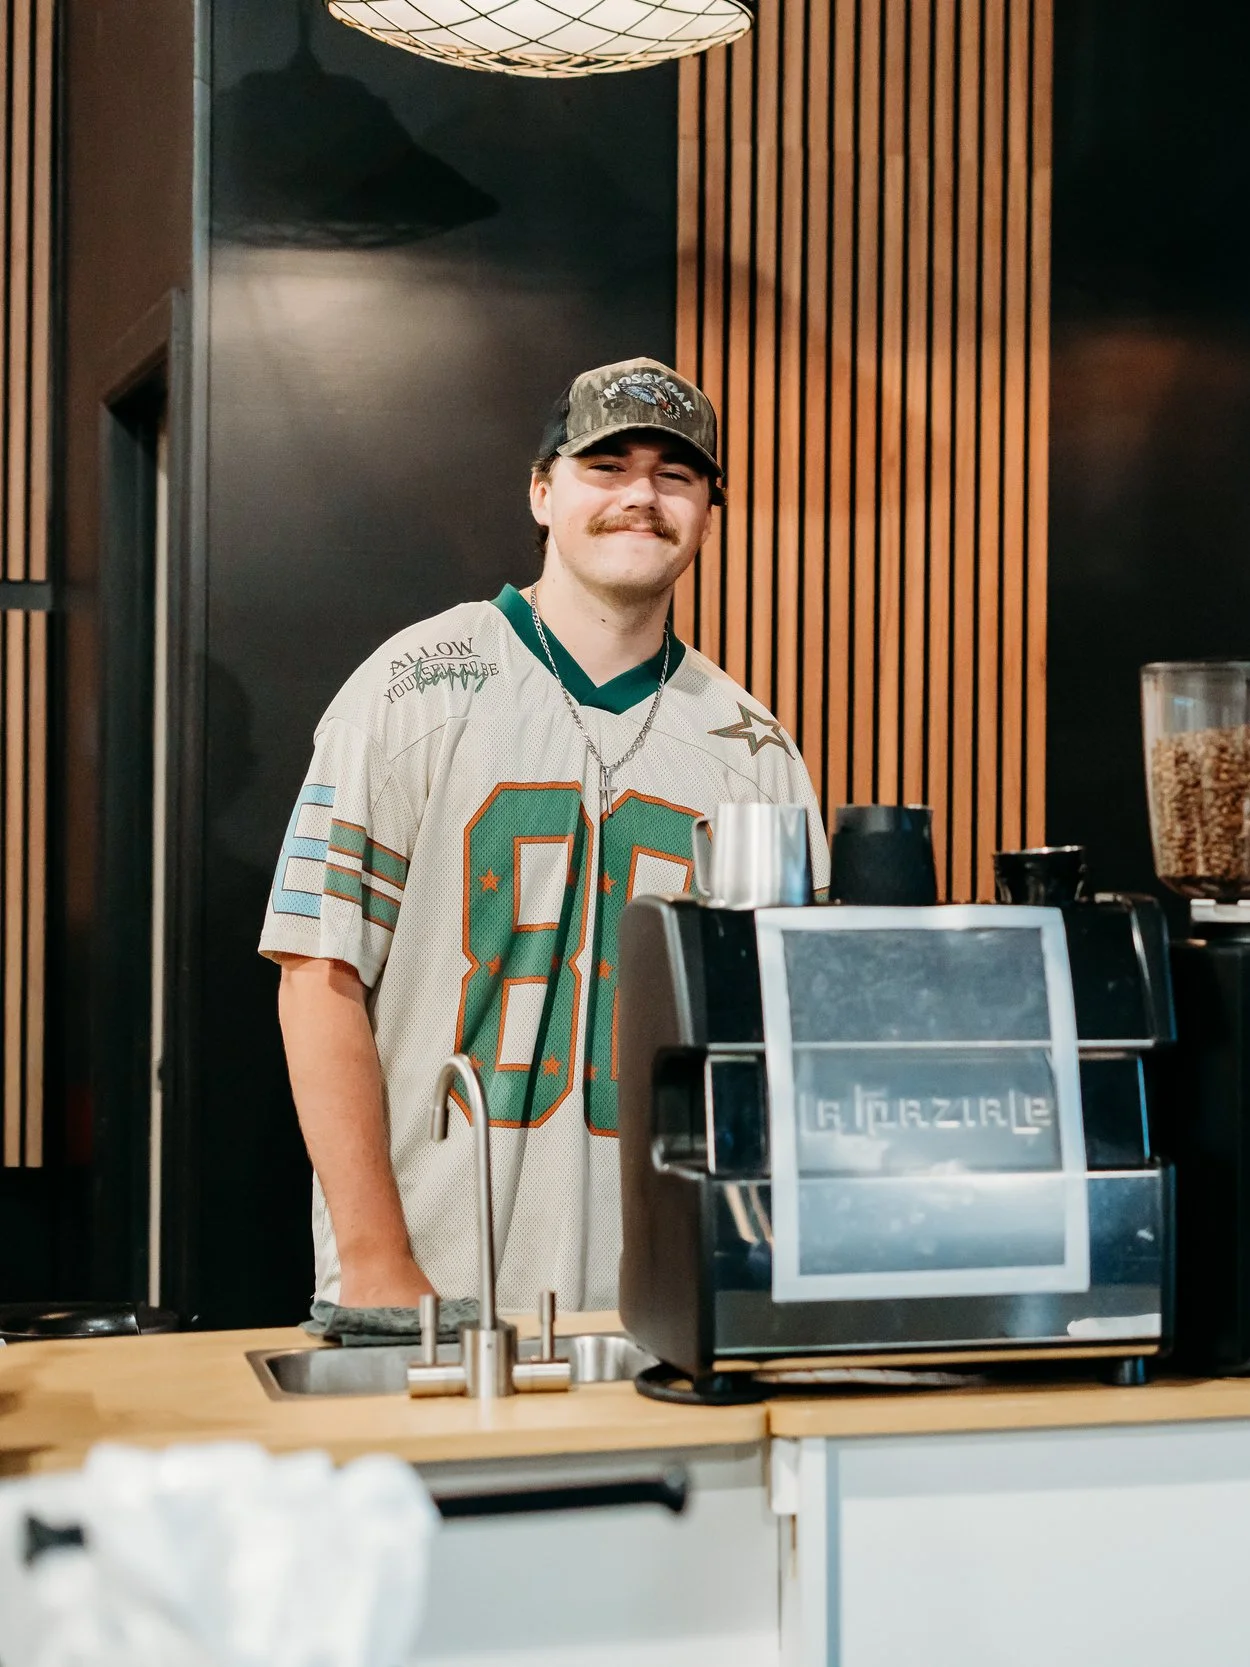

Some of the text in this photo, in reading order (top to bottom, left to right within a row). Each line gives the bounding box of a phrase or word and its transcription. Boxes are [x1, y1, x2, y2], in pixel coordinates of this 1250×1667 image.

[603, 373, 695, 413] MOSSY OAK
[390, 637, 474, 676] ALLOW
[481, 662, 500, 677] BE
